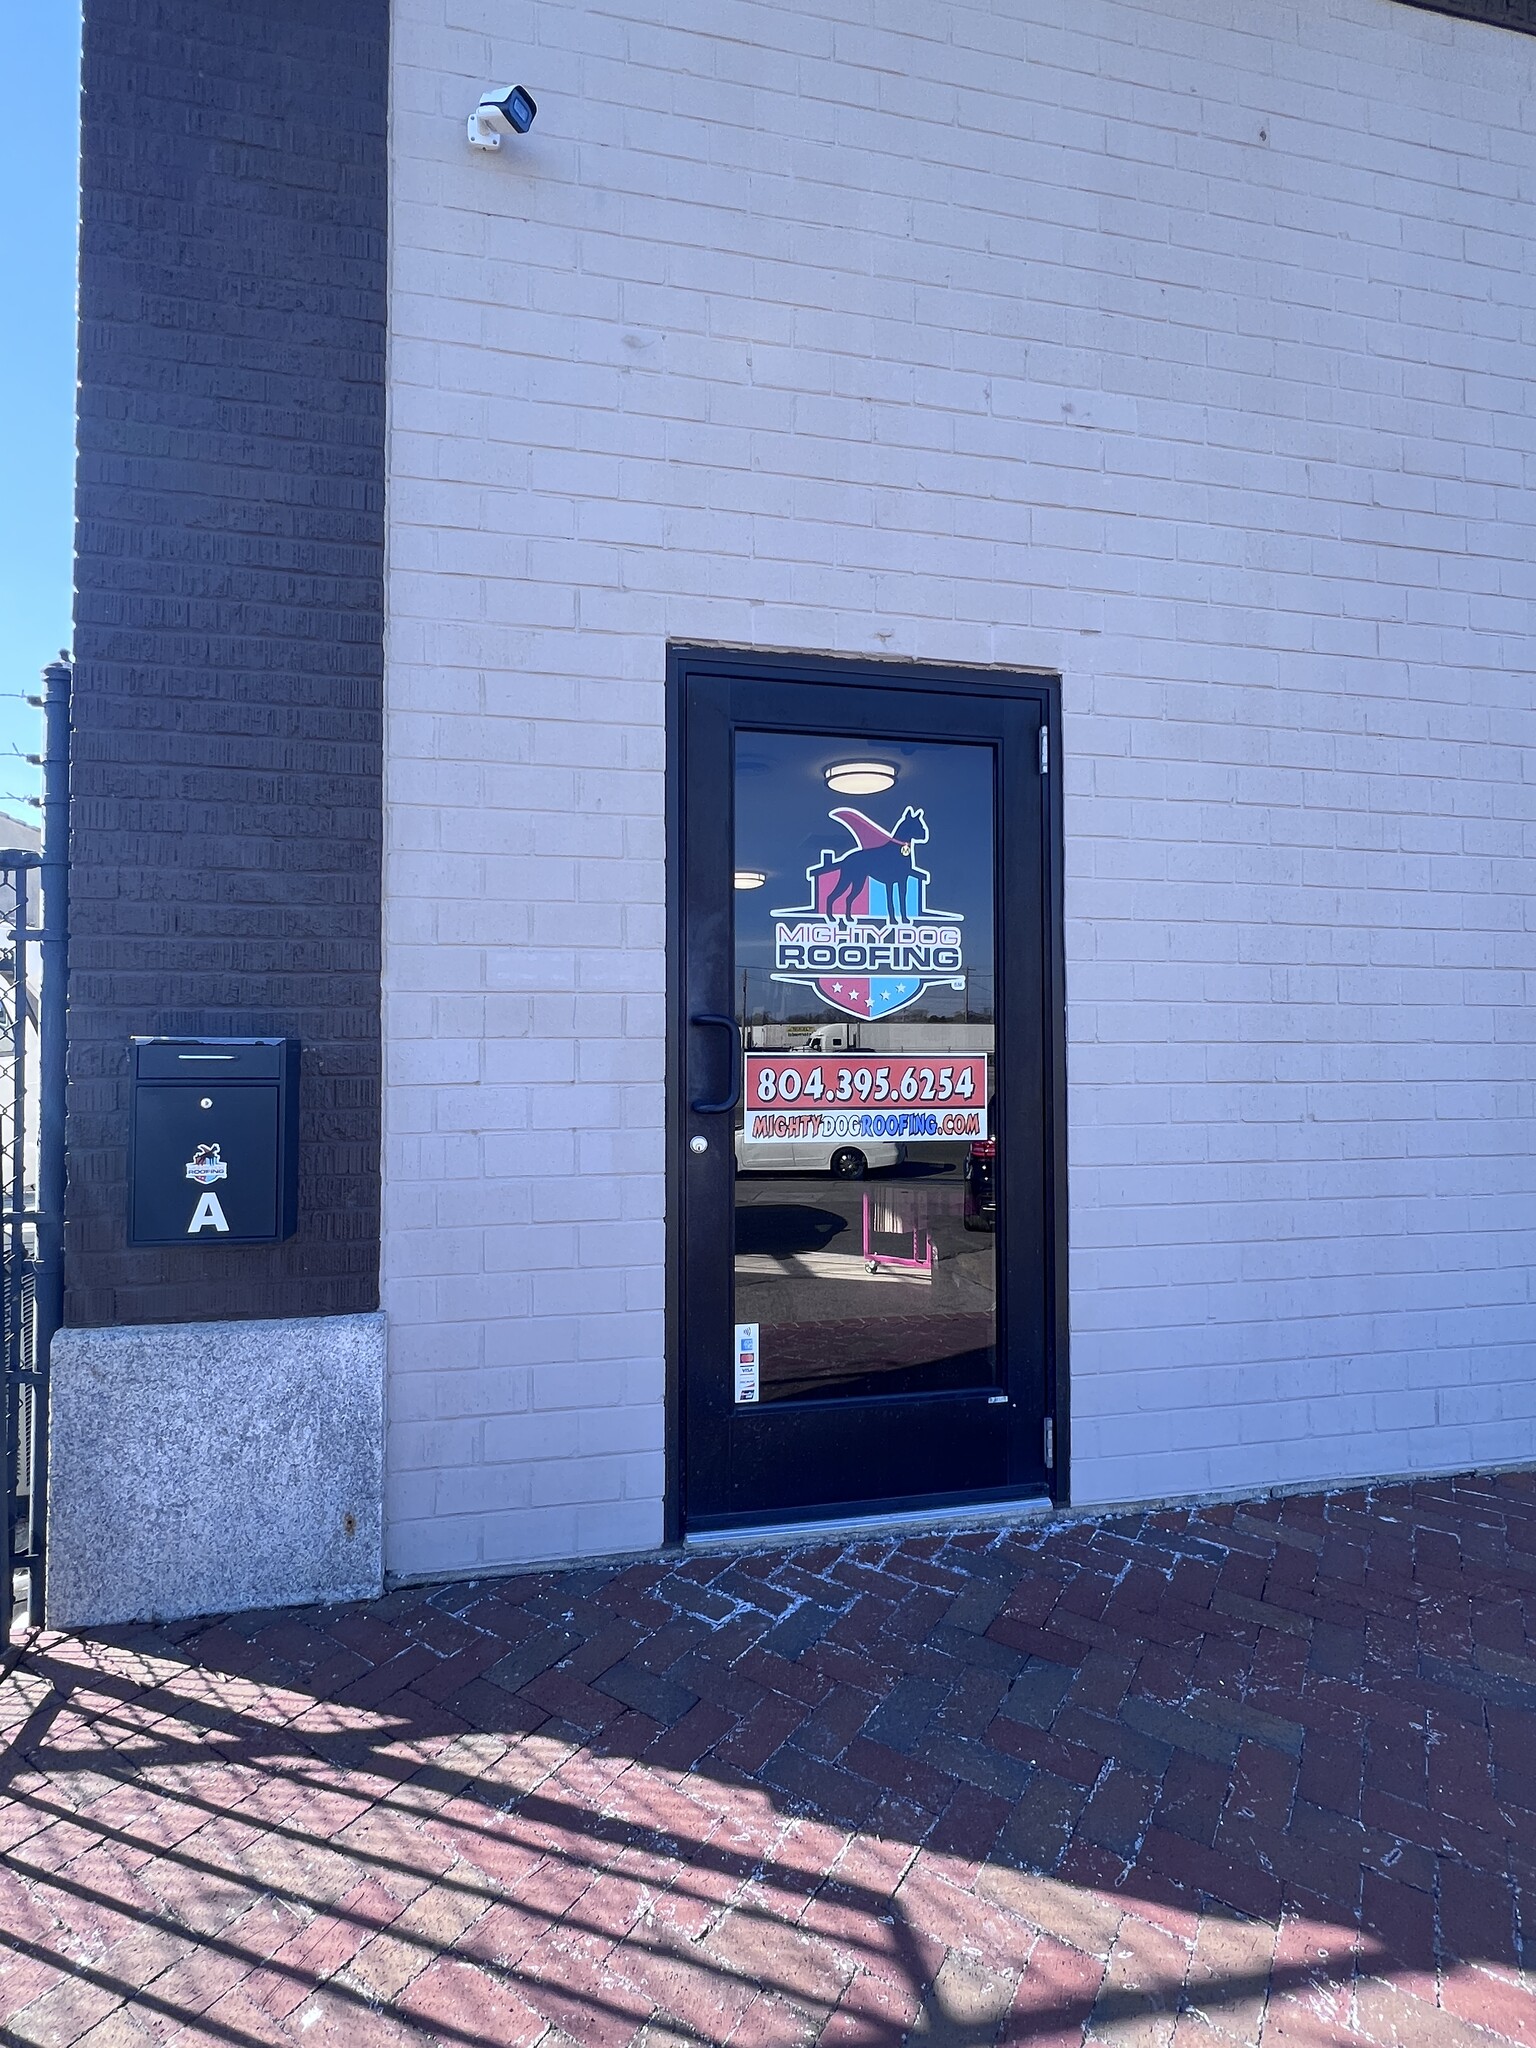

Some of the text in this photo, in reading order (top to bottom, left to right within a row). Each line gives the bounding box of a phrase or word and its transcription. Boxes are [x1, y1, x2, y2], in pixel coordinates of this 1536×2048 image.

[778, 925, 959, 946] MIGHTY DOG
[778, 944, 960, 968] ROOFING
[757, 1066, 975, 1102] 804.395.6254
[752, 1112, 981, 1138] MIGHTYDOGROOFING.COM
[187, 1191, 230, 1233] A
